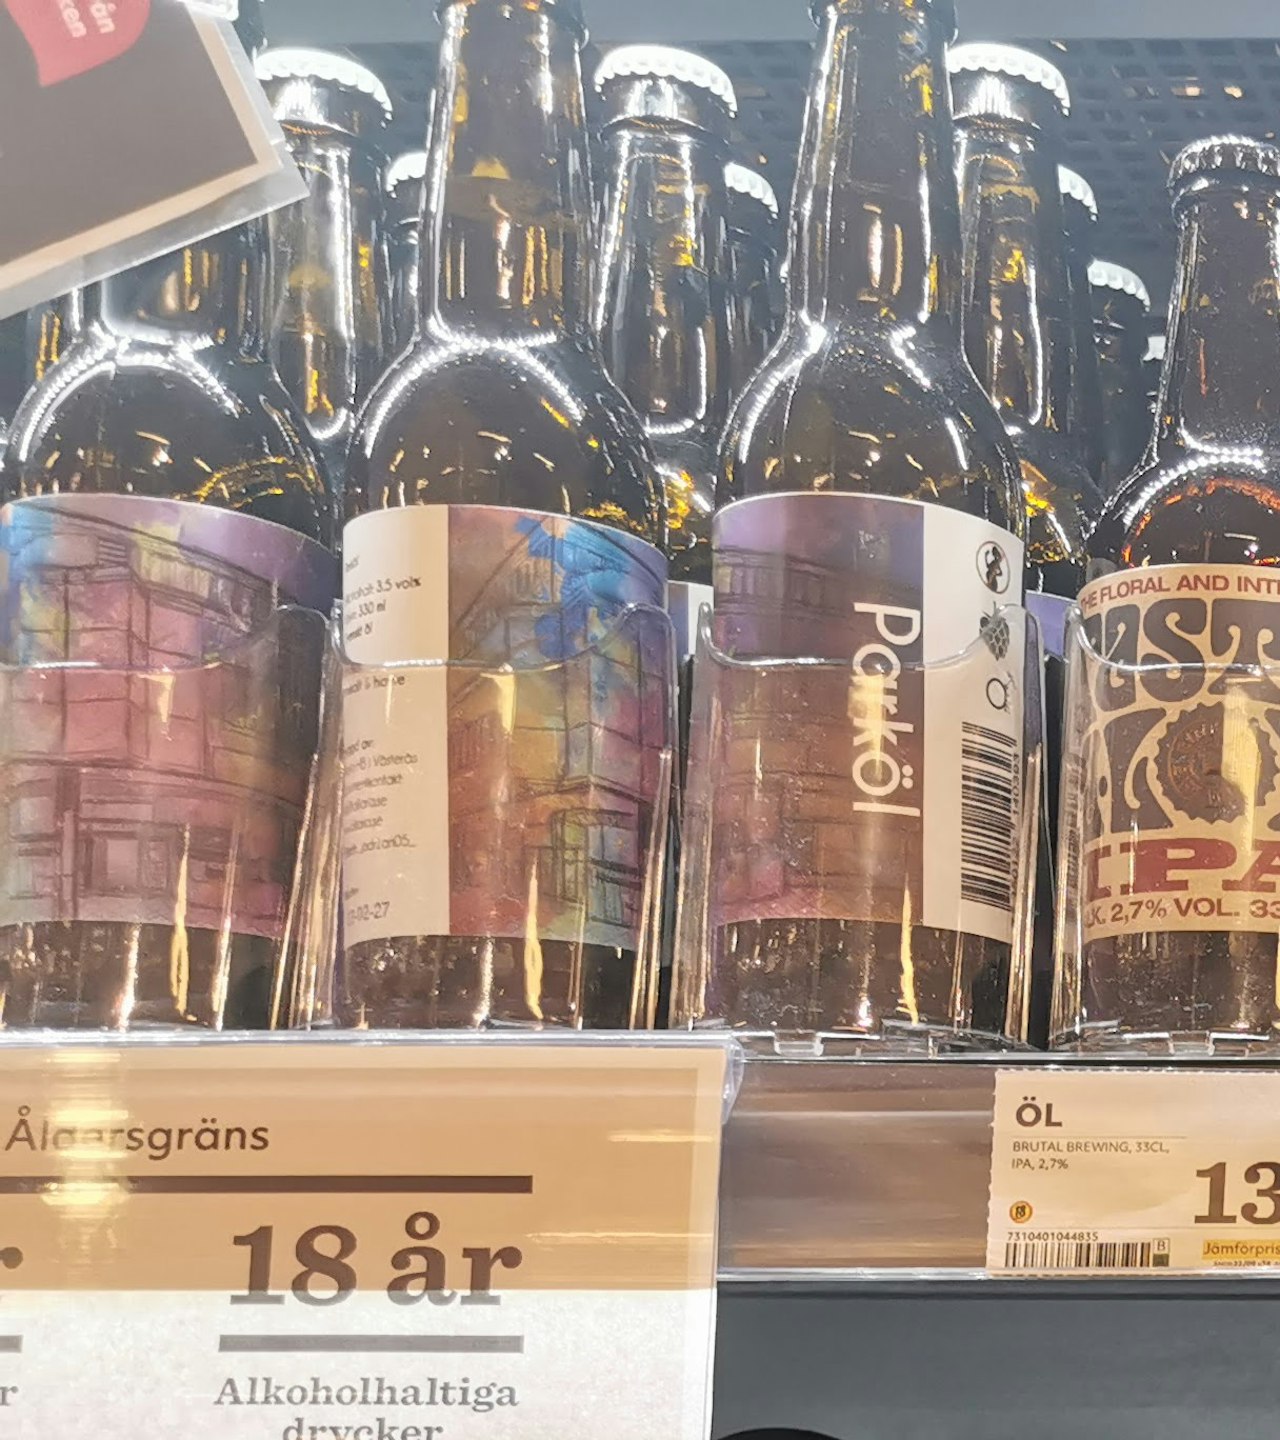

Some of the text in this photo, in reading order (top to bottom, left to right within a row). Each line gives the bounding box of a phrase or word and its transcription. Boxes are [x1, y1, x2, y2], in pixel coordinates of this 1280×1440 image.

[1101, 575, 1170, 601] FLORAL
[1177, 575, 1229, 592] AND
[1111, 899, 1167, 924] 2,7%
[1173, 898, 1240, 917] VOL.
[1015, 1096, 1063, 1128] ÖL
[1012, 1141, 1170, 1153] BRUTAL BREWING, 33CL,
[1012, 1158, 1069, 1170] IPA, 2,7%
[229, 1211, 524, 1307] 18 år
[214, 1377, 520, 1413] Alkoholhaltiga
